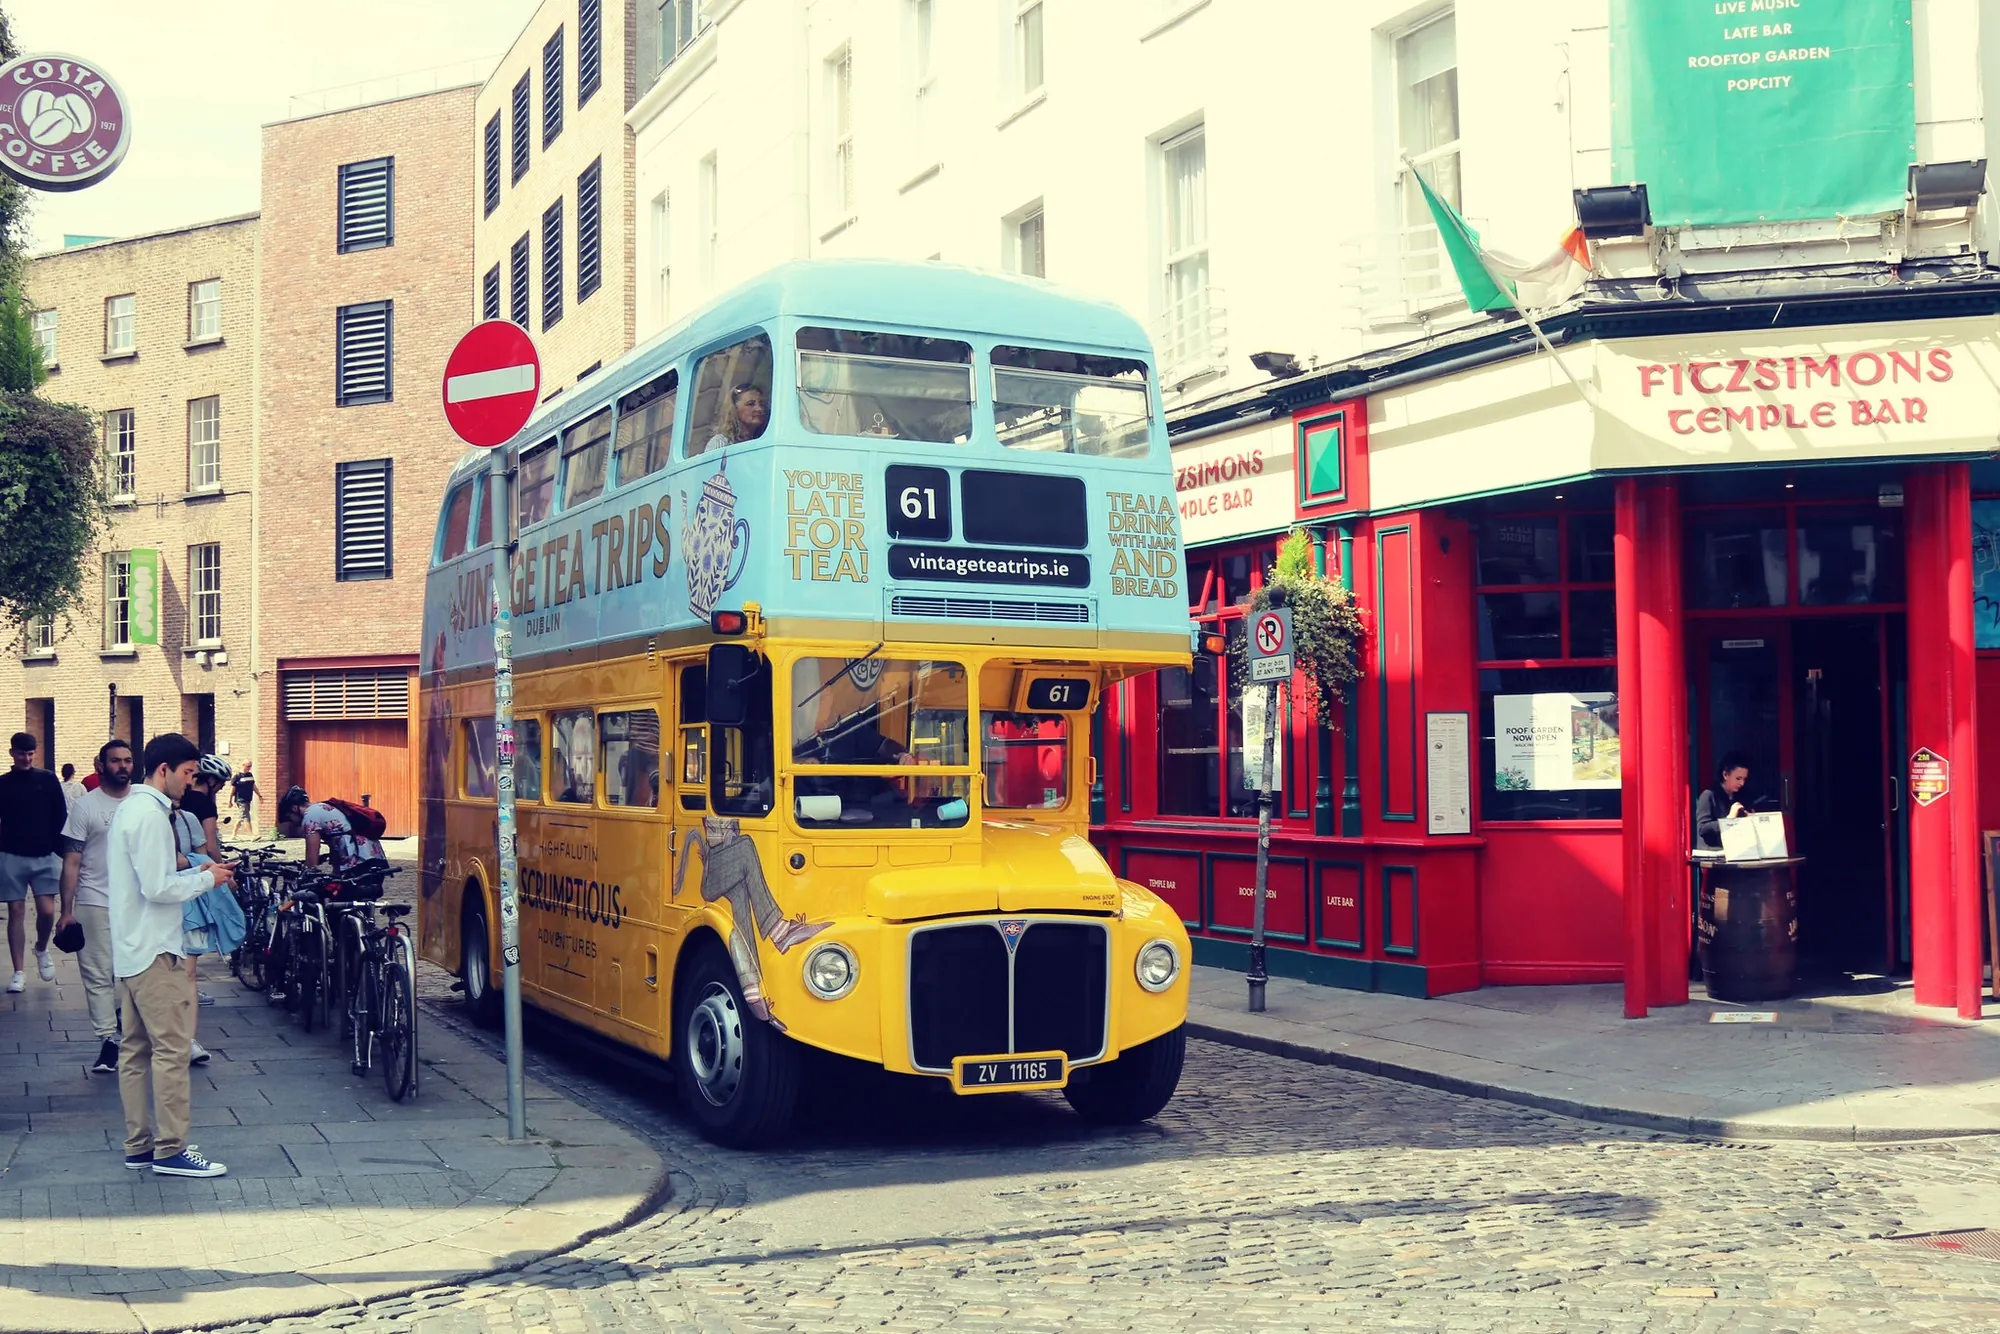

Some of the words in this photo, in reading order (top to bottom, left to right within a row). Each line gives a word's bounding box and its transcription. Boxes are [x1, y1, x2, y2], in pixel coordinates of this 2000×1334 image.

[1715, 2, 1747, 15] LIVE
[1751, 0, 1800, 12] MUSIC
[1724, 26, 1757, 40] LATE
[1762, 23, 1792, 36] BAR
[1688, 52, 1761, 68] ROOFTOP
[1765, 47, 1830, 63] GARDEN
[13, 61, 105, 99] COSTA
[1727, 76, 1792, 91] POPCITY
[101, 121, 115, 131] 1971
[1637, 348, 1953, 397] FITZSIMONS
[1668, 402, 1837, 434] TEMPLE
[1848, 397, 1928, 425] BAR
[783, 469, 864, 491] YOU'RE
[1176, 449, 1263, 492] ZSIMONS
[786, 490, 866, 518] LATE
[900, 487, 936, 519] 61
[1158, 496, 1174, 516] A
[1179, 495, 1218, 519] MPLE
[1222, 488, 1253, 511] BAR
[787, 517, 868, 551] FOR
[1108, 512, 1177, 536] DRINK
[1108, 533, 1145, 549] WITH
[1147, 535, 1177, 551] JAM
[458, 547, 537, 631] VINGE
[543, 529, 587, 610] TEA
[592, 494, 672, 595] TRIPS
[784, 549, 869, 584] TEA!
[908, 553, 1069, 578] vintageteatrips.ie
[1110, 548, 1178, 579] AND
[1112, 576, 1179, 599] BREAD
[526, 612, 561, 638] DUBLIN
[1049, 685, 1069, 703] 61
[1506, 727, 1528, 735] ROOF
[1531, 726, 1564, 734] GARDEN
[540, 840, 598, 862] HIGHFALUTIN
[1149, 879, 1166, 889] TEMPLE
[1166, 880, 1176, 890] BAR
[1239, 887, 1254, 896] ROOF
[520, 867, 620, 929] SCRUMPTIOUS
[1327, 896, 1341, 906] LATE
[1342, 898, 1354, 907] BAR
[538, 927, 597, 959] ADVENTURES
[979, 1064, 998, 1083] ZV
[1010, 1062, 1047, 1081] 11165
